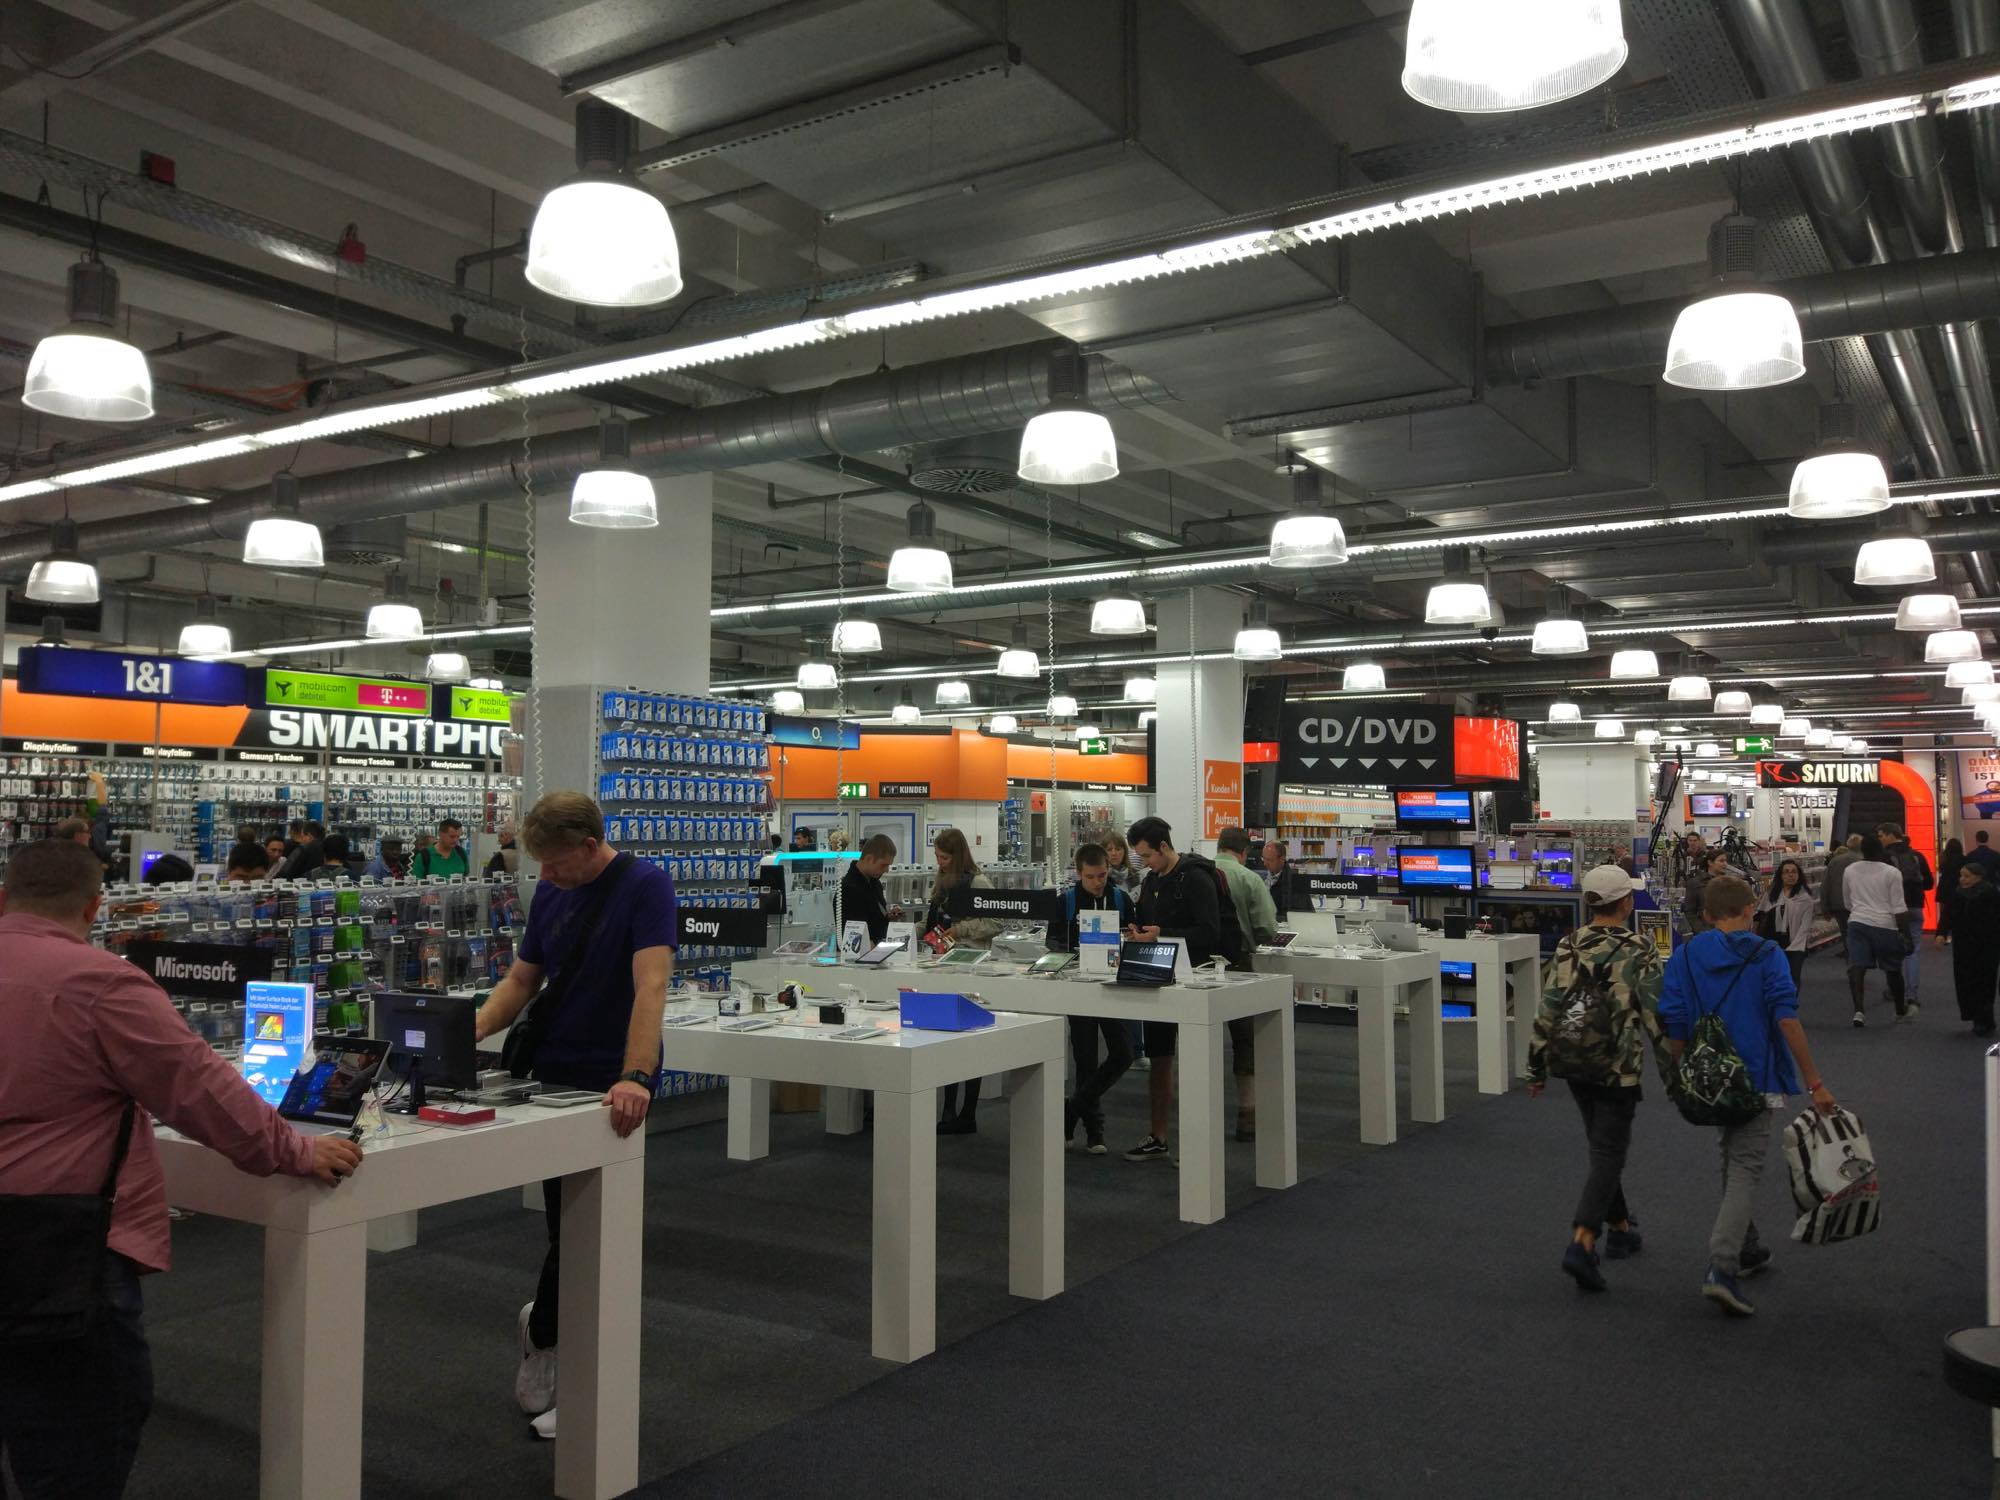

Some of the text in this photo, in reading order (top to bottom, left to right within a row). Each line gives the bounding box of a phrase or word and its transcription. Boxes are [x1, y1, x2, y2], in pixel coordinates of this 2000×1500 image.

[122, 660, 171, 694] 1&1
[299, 681, 347, 693] mobilcom
[1299, 716, 1437, 746] CD/DVD
[22, 741, 78, 753] Displayfolien
[240, 751, 304, 762] Samsung Taschen
[336, 756, 395, 767] Samsung Taschen
[1801, 763, 1878, 783] SATURN
[900, 785, 928, 794] KUNDEN
[1211, 783, 1231, 793] Kunden
[1215, 812, 1239, 826] Aufzug
[1310, 879, 1358, 891] Bluetooth
[973, 896, 1030, 914] Samsung
[685, 917, 720, 938] Sony
[155, 956, 236, 982] Microsoft
